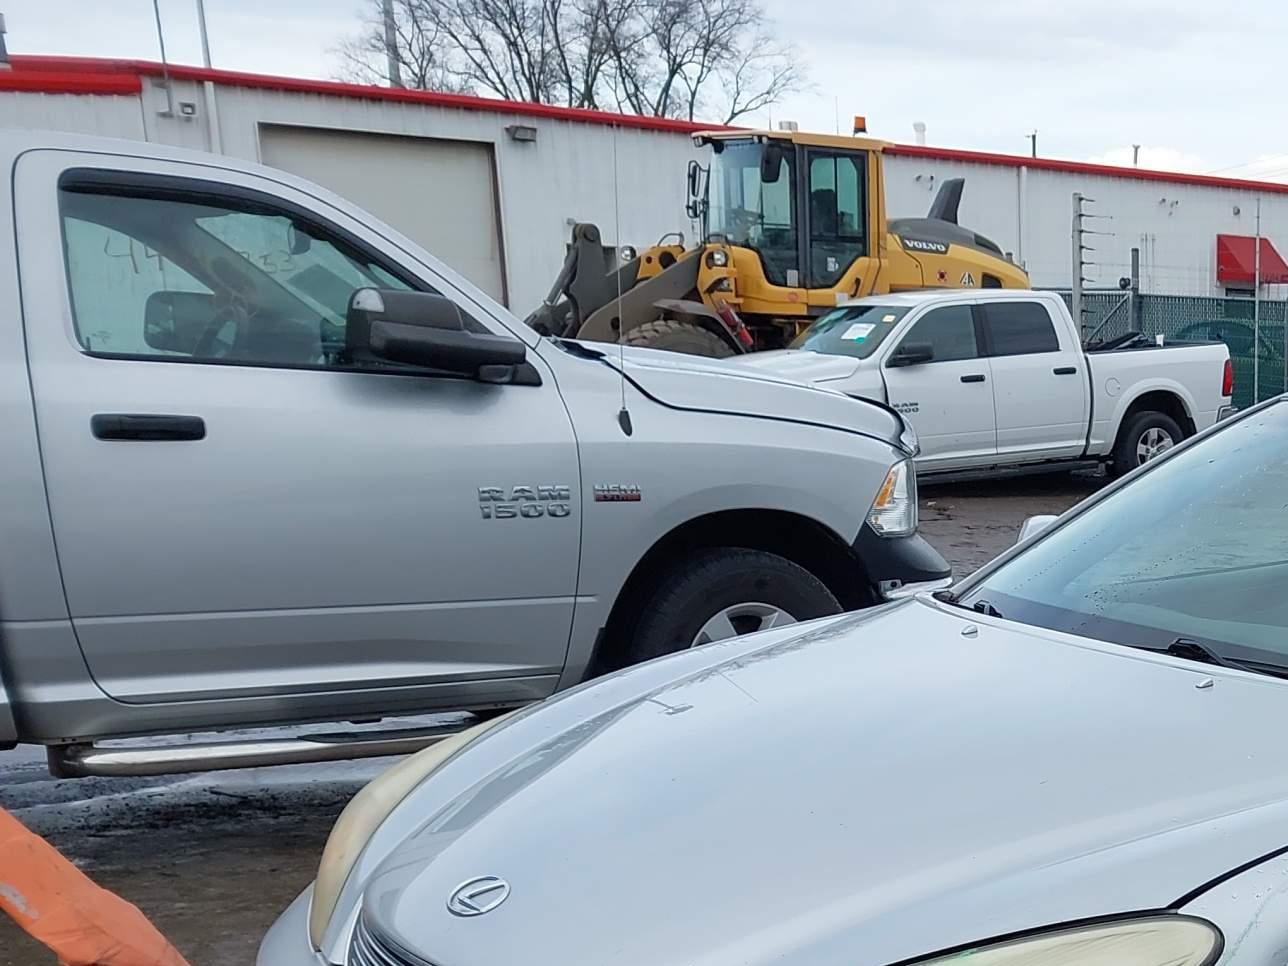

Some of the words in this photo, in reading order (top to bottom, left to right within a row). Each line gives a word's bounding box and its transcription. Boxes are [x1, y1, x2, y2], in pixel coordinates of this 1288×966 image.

[904, 239, 946, 252] VOLVO
[478, 485, 570, 501] RAM
[480, 503, 570, 519] 1500
